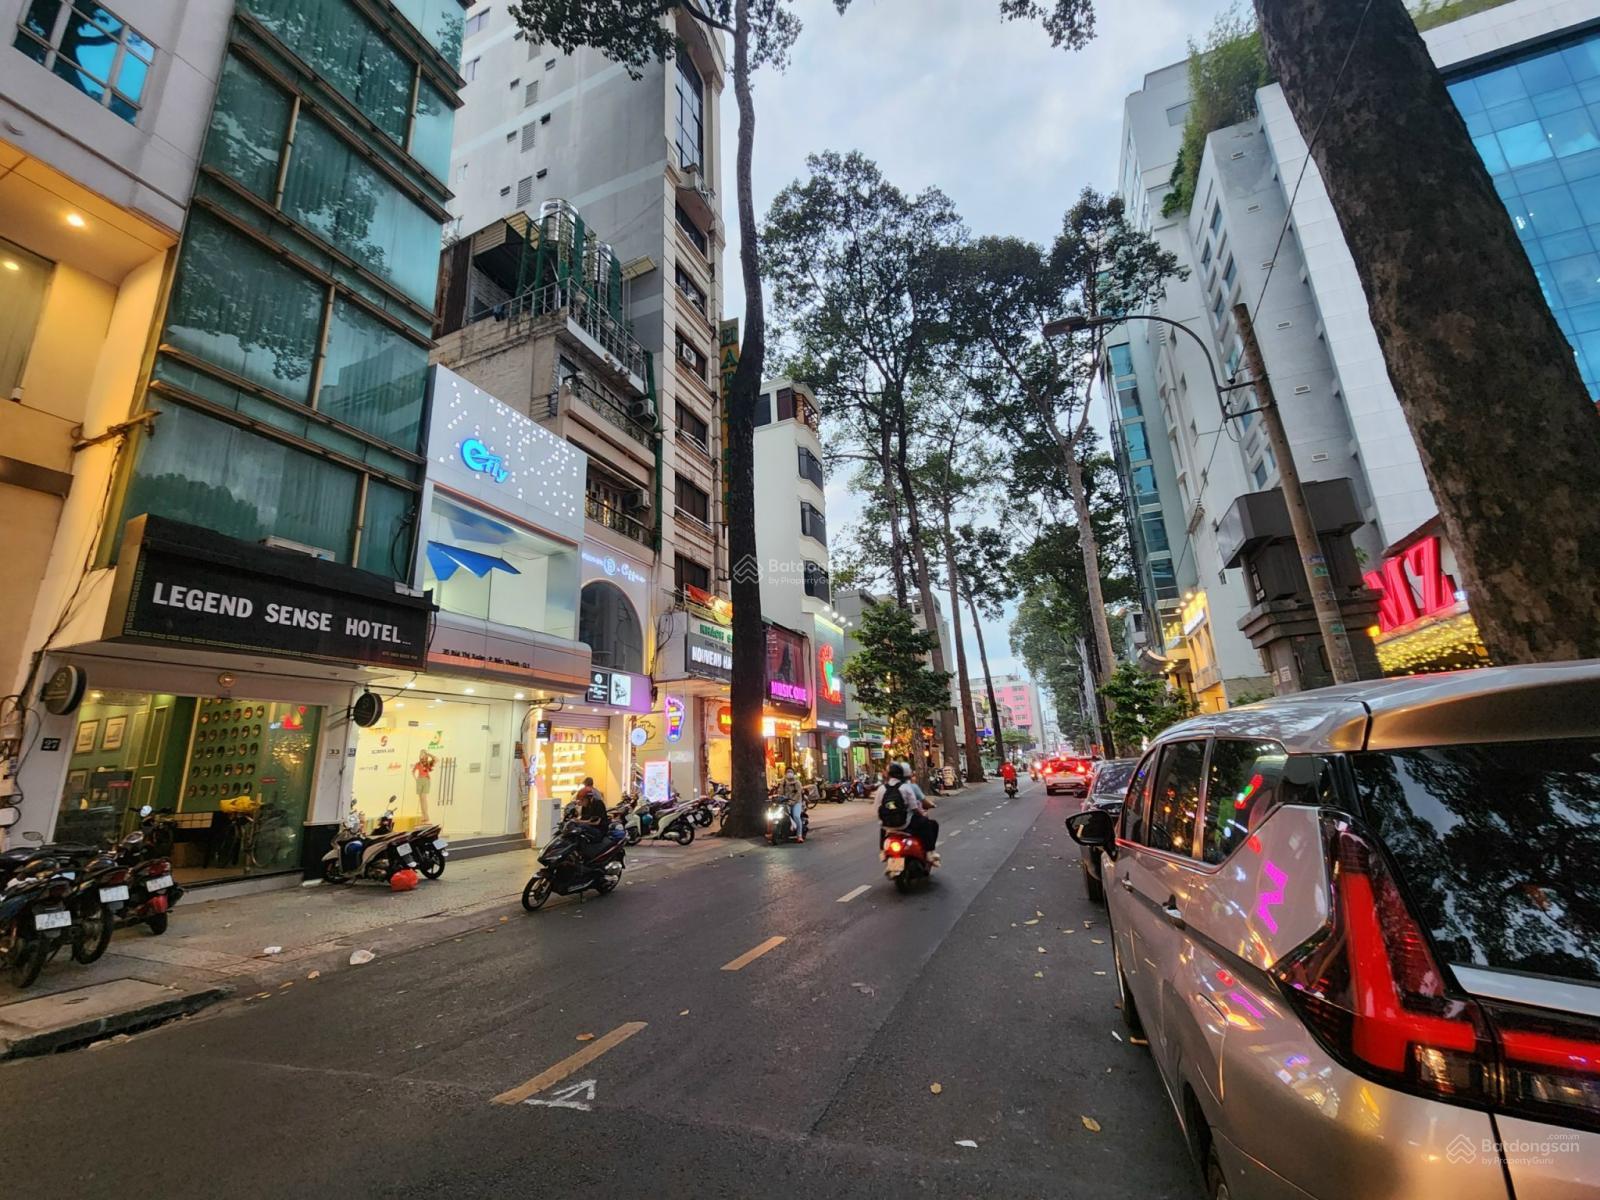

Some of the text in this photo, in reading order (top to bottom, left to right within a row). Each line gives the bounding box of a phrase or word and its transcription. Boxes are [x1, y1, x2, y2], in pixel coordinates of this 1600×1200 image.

[152, 582, 253, 618] LEGEND
[264, 603, 333, 632] SENSE
[692, 646, 722, 668] NOUVEAU
[771, 681, 793, 699] MUSIC
